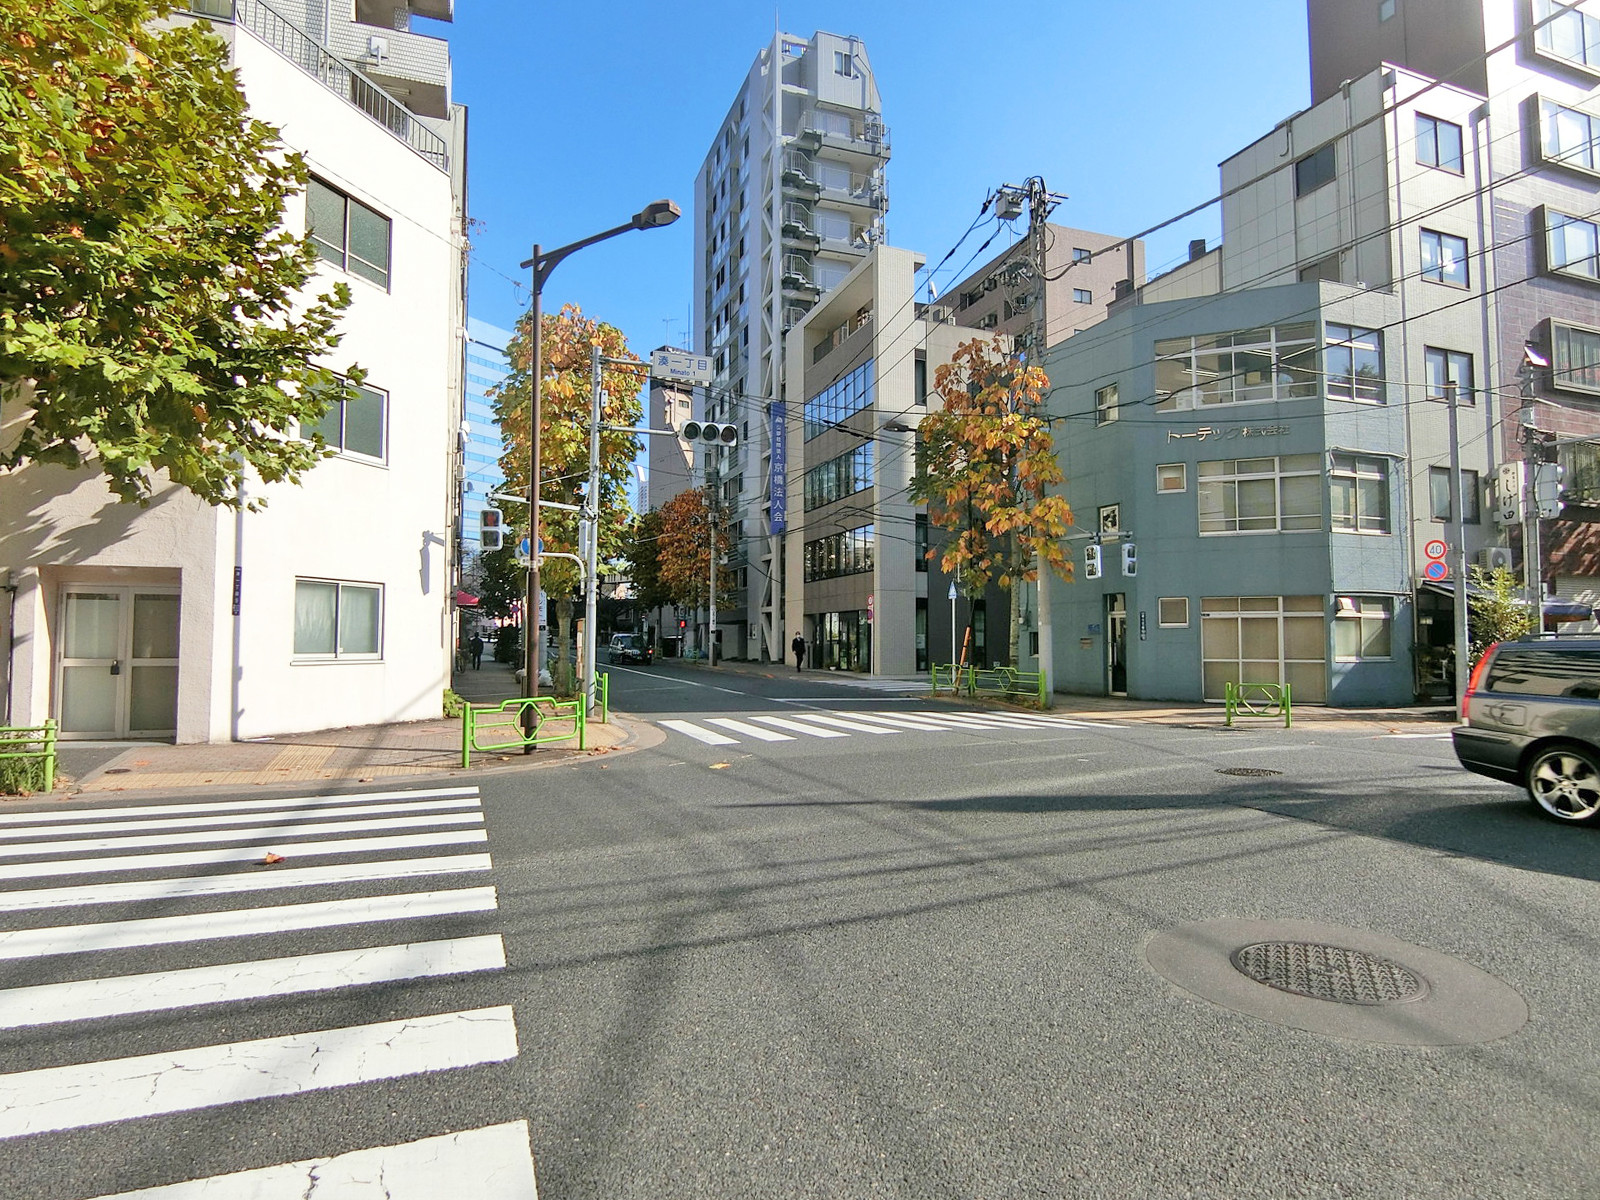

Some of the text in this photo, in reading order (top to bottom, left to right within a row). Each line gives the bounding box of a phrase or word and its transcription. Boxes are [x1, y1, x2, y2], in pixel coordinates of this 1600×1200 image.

[658, 355, 707, 370] 湊一丁目
[670, 368, 690, 376] Minato
[773, 462, 784, 522] 京橋法人会
[1430, 545, 1442, 555] 40
